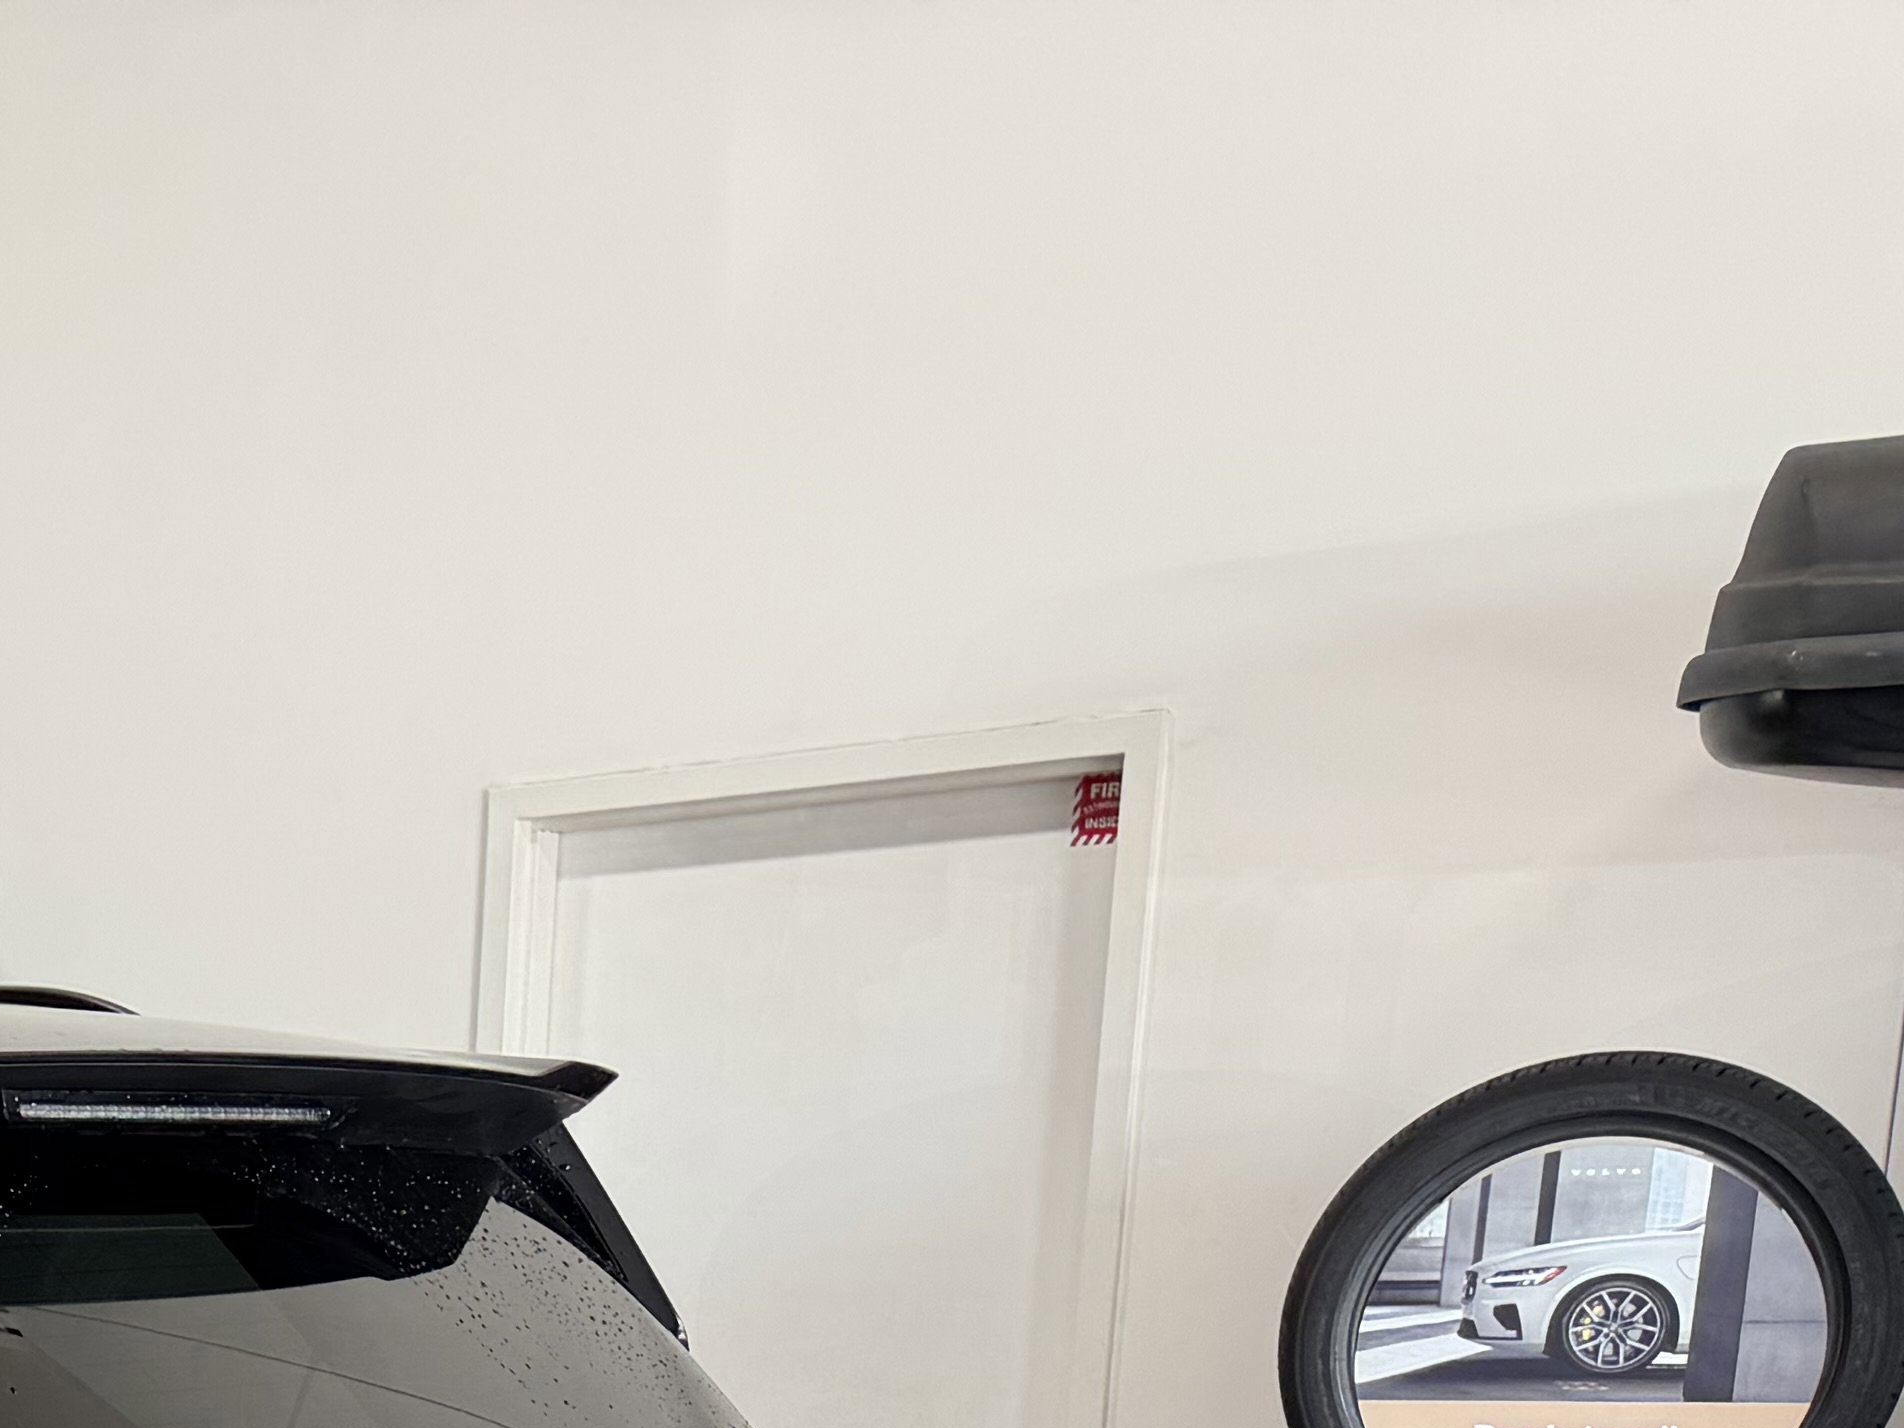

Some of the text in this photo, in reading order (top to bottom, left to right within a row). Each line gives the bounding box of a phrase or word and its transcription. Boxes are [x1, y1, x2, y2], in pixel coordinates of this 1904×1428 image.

[1090, 782, 1121, 800] FIR
[1085, 816, 1118, 829] INSID
[1571, 1167, 1642, 1177] VOLVO
